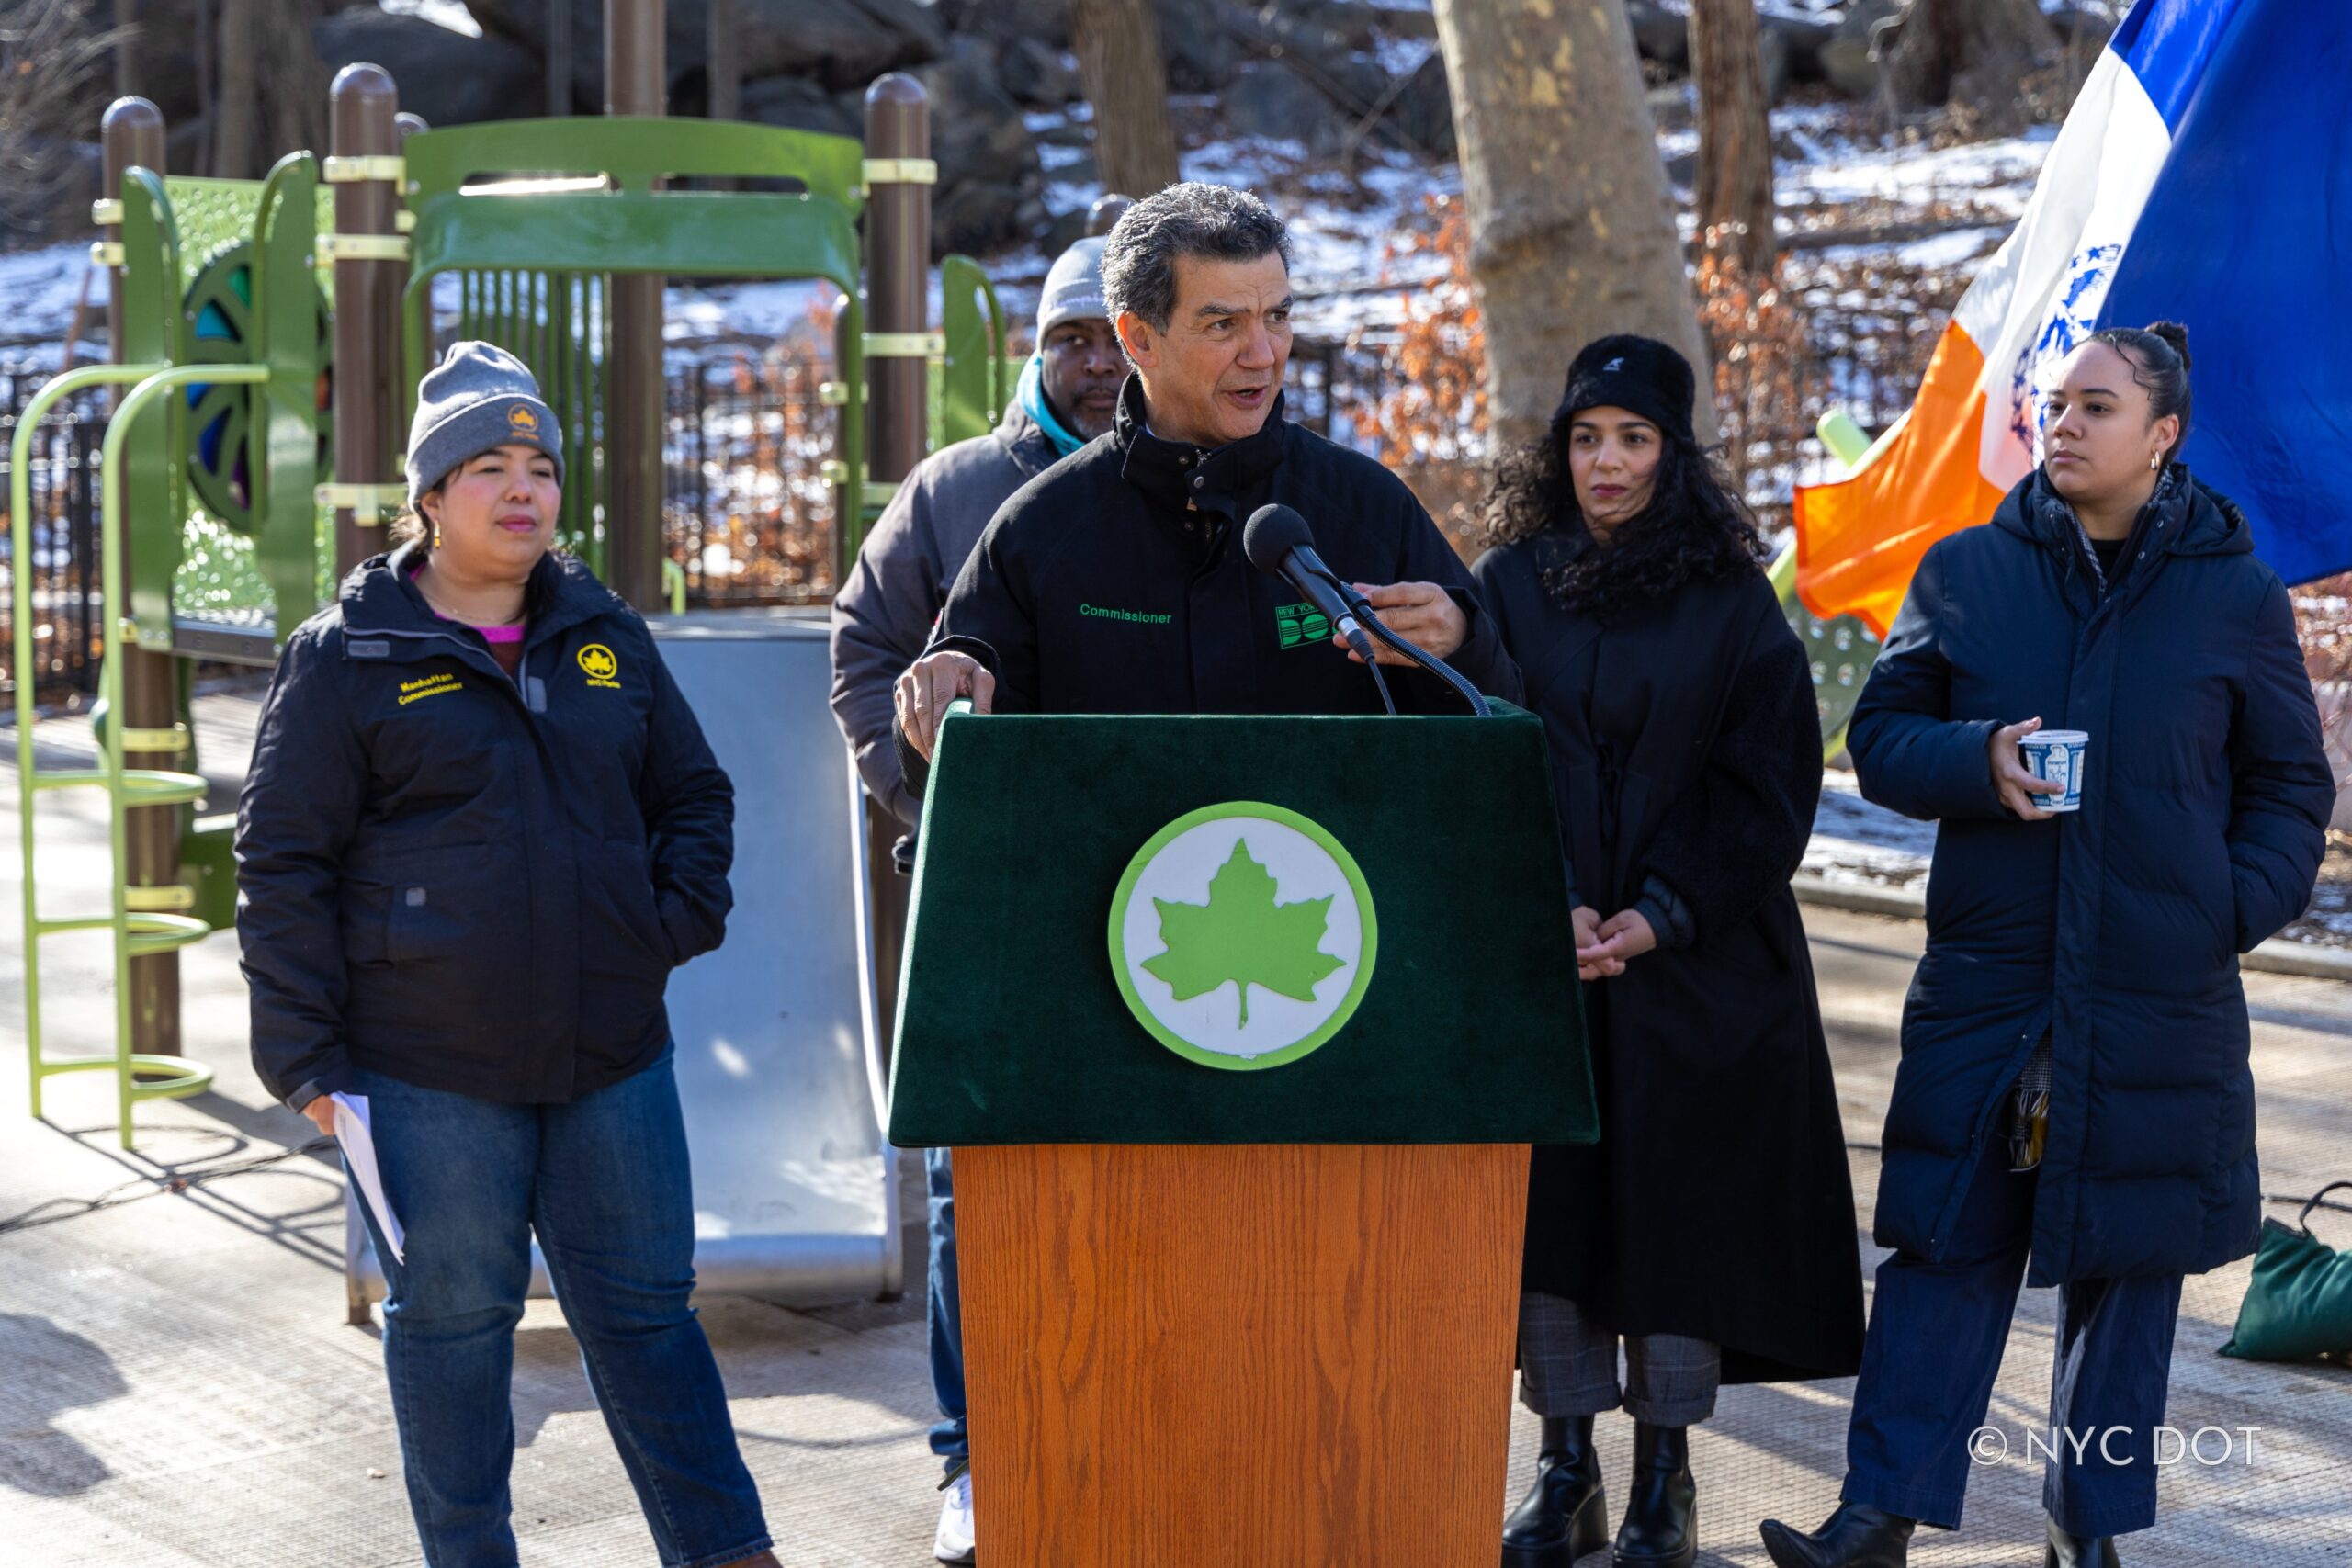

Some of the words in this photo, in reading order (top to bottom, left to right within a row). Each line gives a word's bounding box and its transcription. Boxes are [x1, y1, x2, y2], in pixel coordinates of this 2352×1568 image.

[1080, 604, 1172, 624] Commissioner
[1278, 607, 1295, 616] NEW
[400, 673, 454, 693] Manhattan
[398, 682, 463, 705] Commissioner
